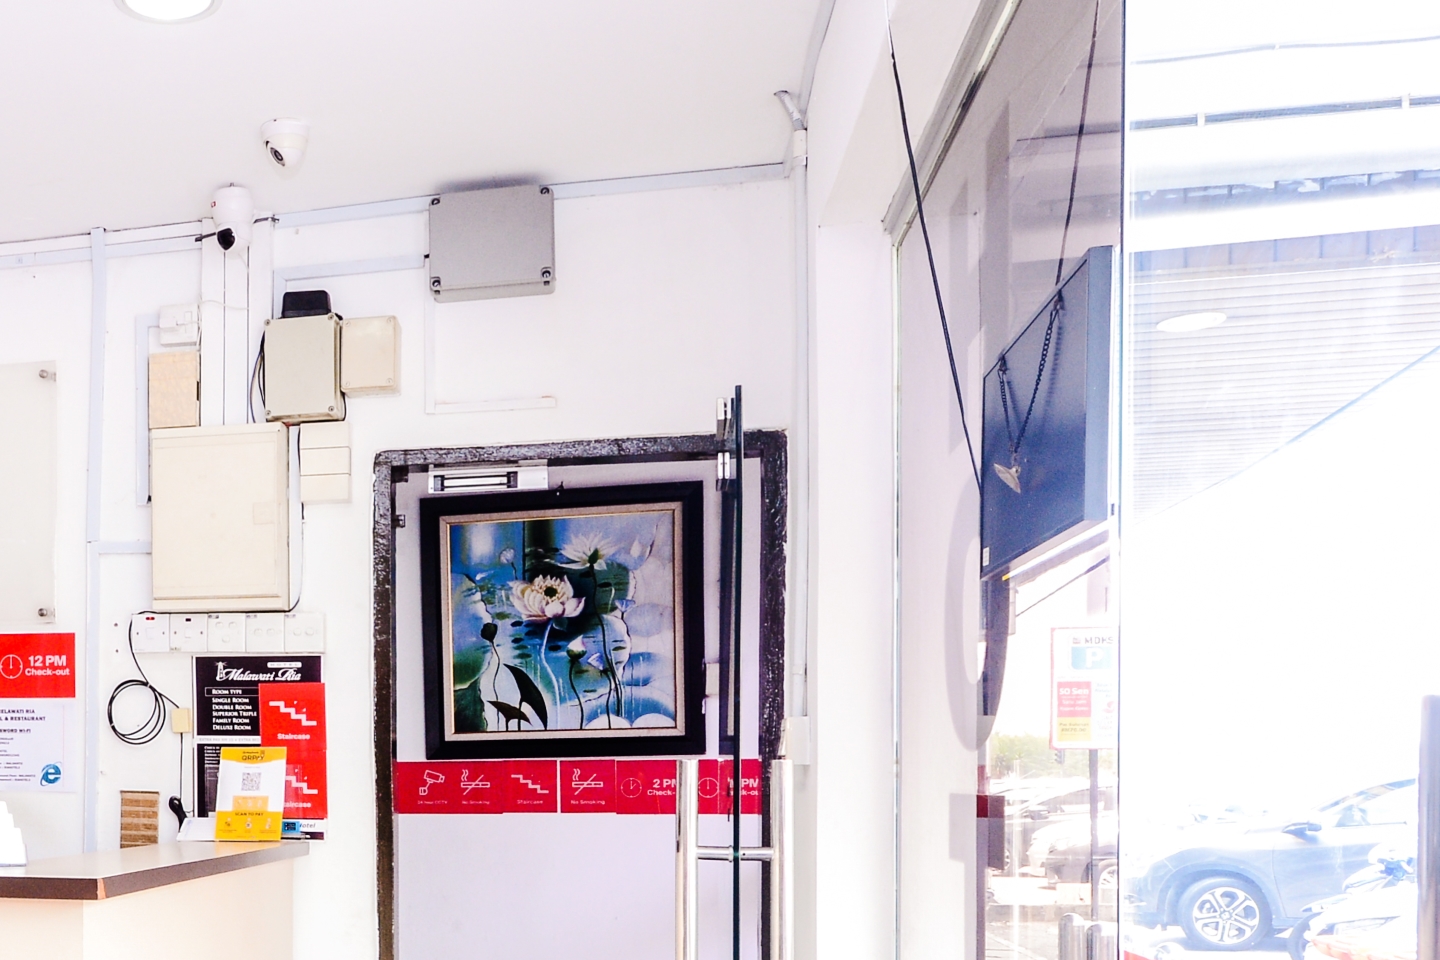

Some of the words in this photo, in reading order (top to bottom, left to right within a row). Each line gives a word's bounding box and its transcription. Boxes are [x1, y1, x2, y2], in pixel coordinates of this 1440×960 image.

[28, 655, 44, 667] 12
[45, 655, 67, 667] PM
[25, 667, 70, 676] Check-out
[275, 667, 301, 681] Ria
[653, 779, 660, 788] 2
